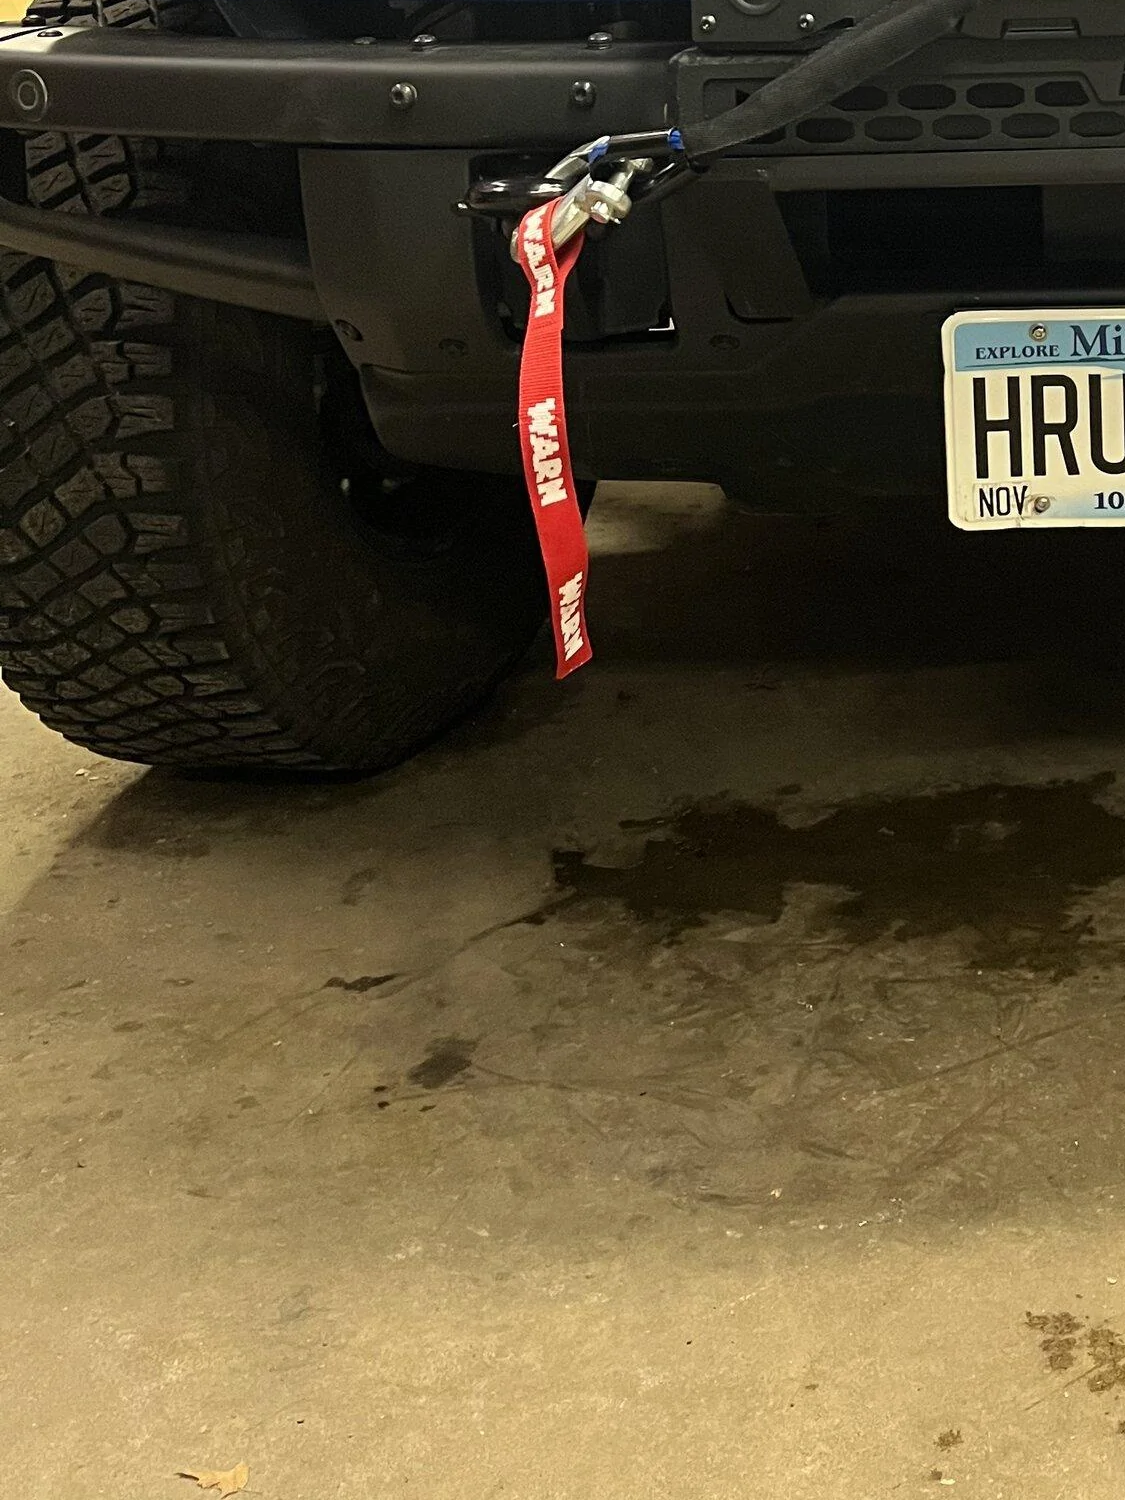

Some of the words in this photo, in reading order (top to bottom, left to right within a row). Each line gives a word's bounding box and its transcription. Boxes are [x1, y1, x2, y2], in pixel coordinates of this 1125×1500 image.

[522, 205, 556, 318] WARN
[975, 342, 1060, 361] EXPLORE
[526, 398, 568, 507] WARN
[978, 485, 1029, 518] NOV
[555, 572, 585, 662] WARN
